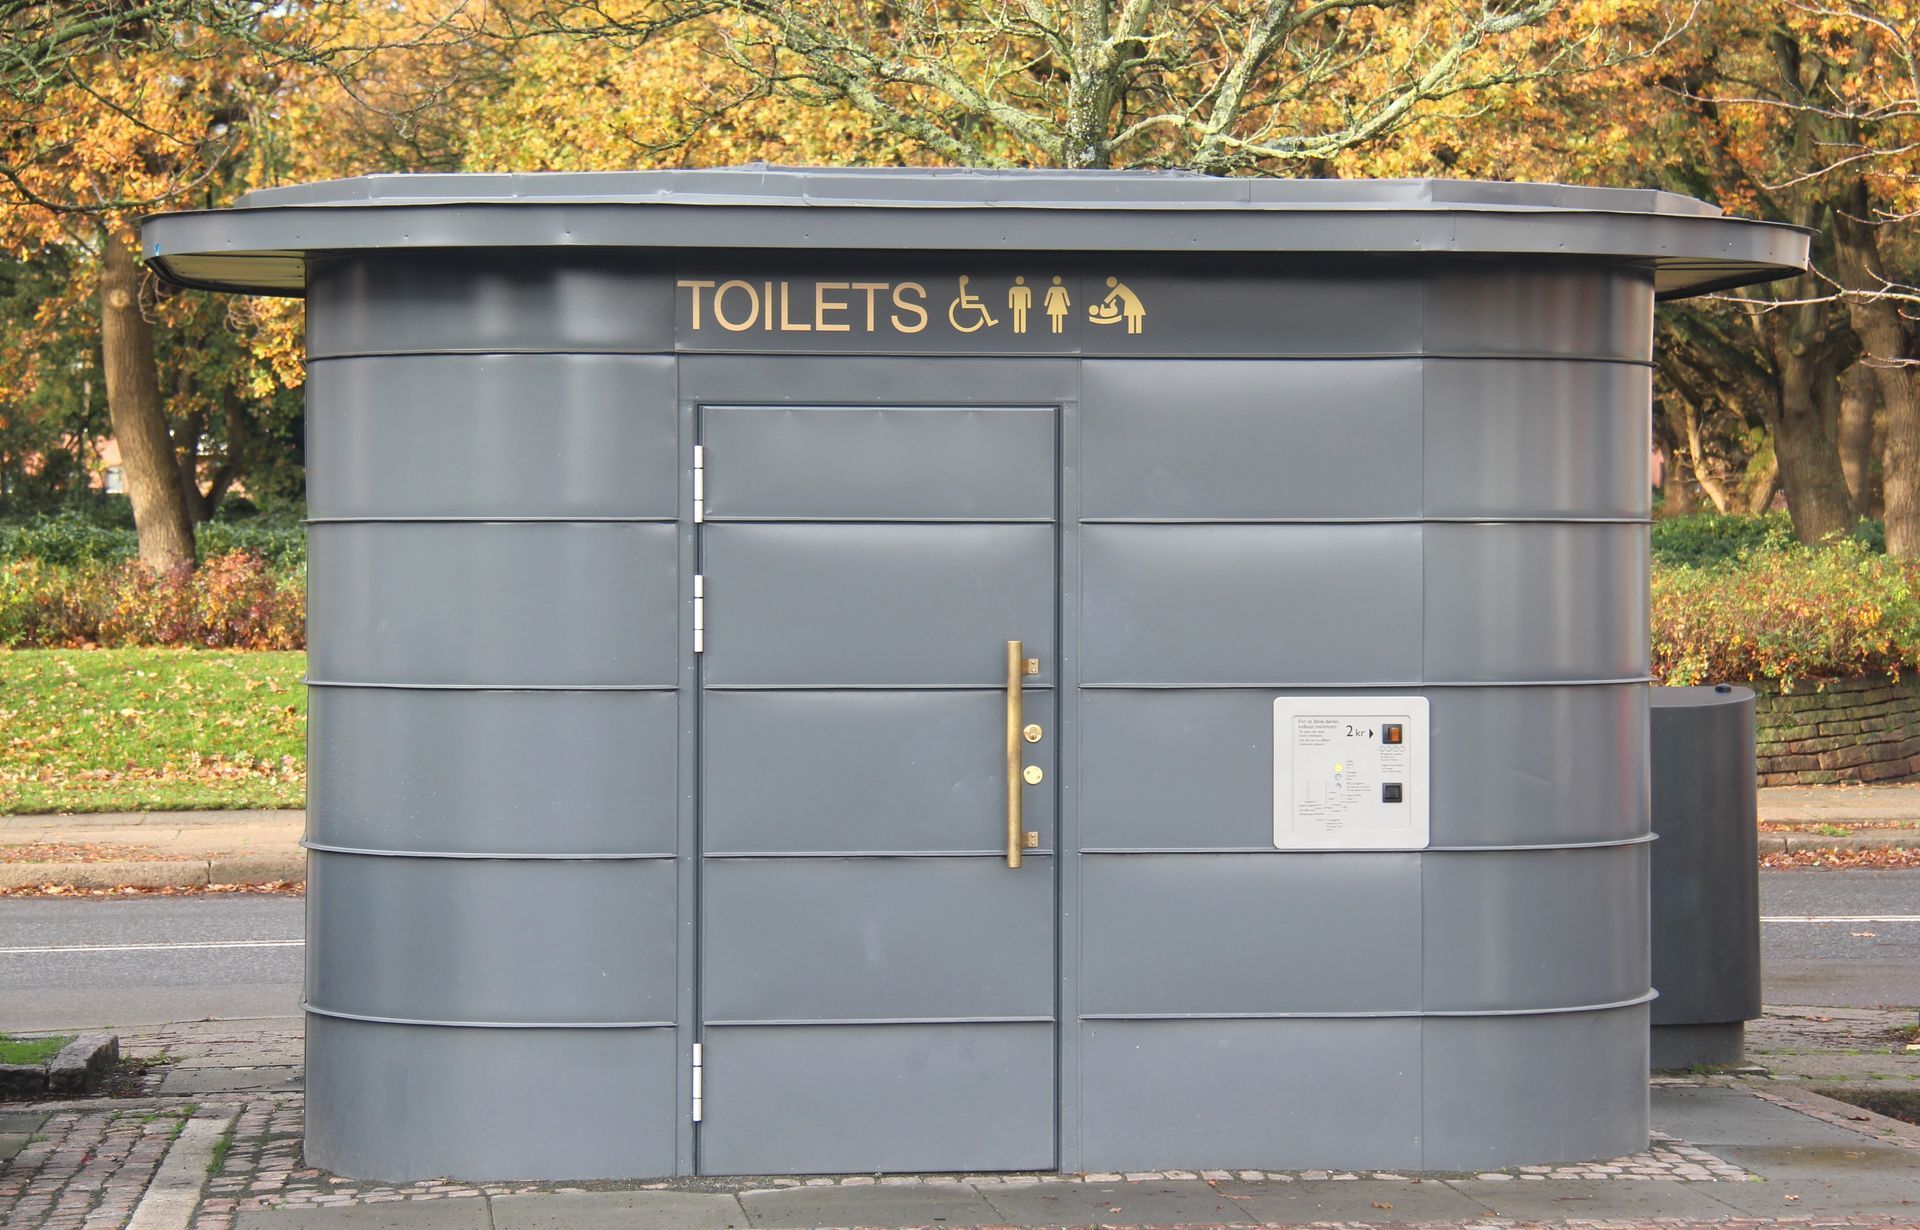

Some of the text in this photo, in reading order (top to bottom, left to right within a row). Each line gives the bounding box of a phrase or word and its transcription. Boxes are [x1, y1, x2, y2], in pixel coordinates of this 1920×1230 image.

[677, 280, 928, 333] TOILETS
[1346, 724, 1365, 737] 2 kr
